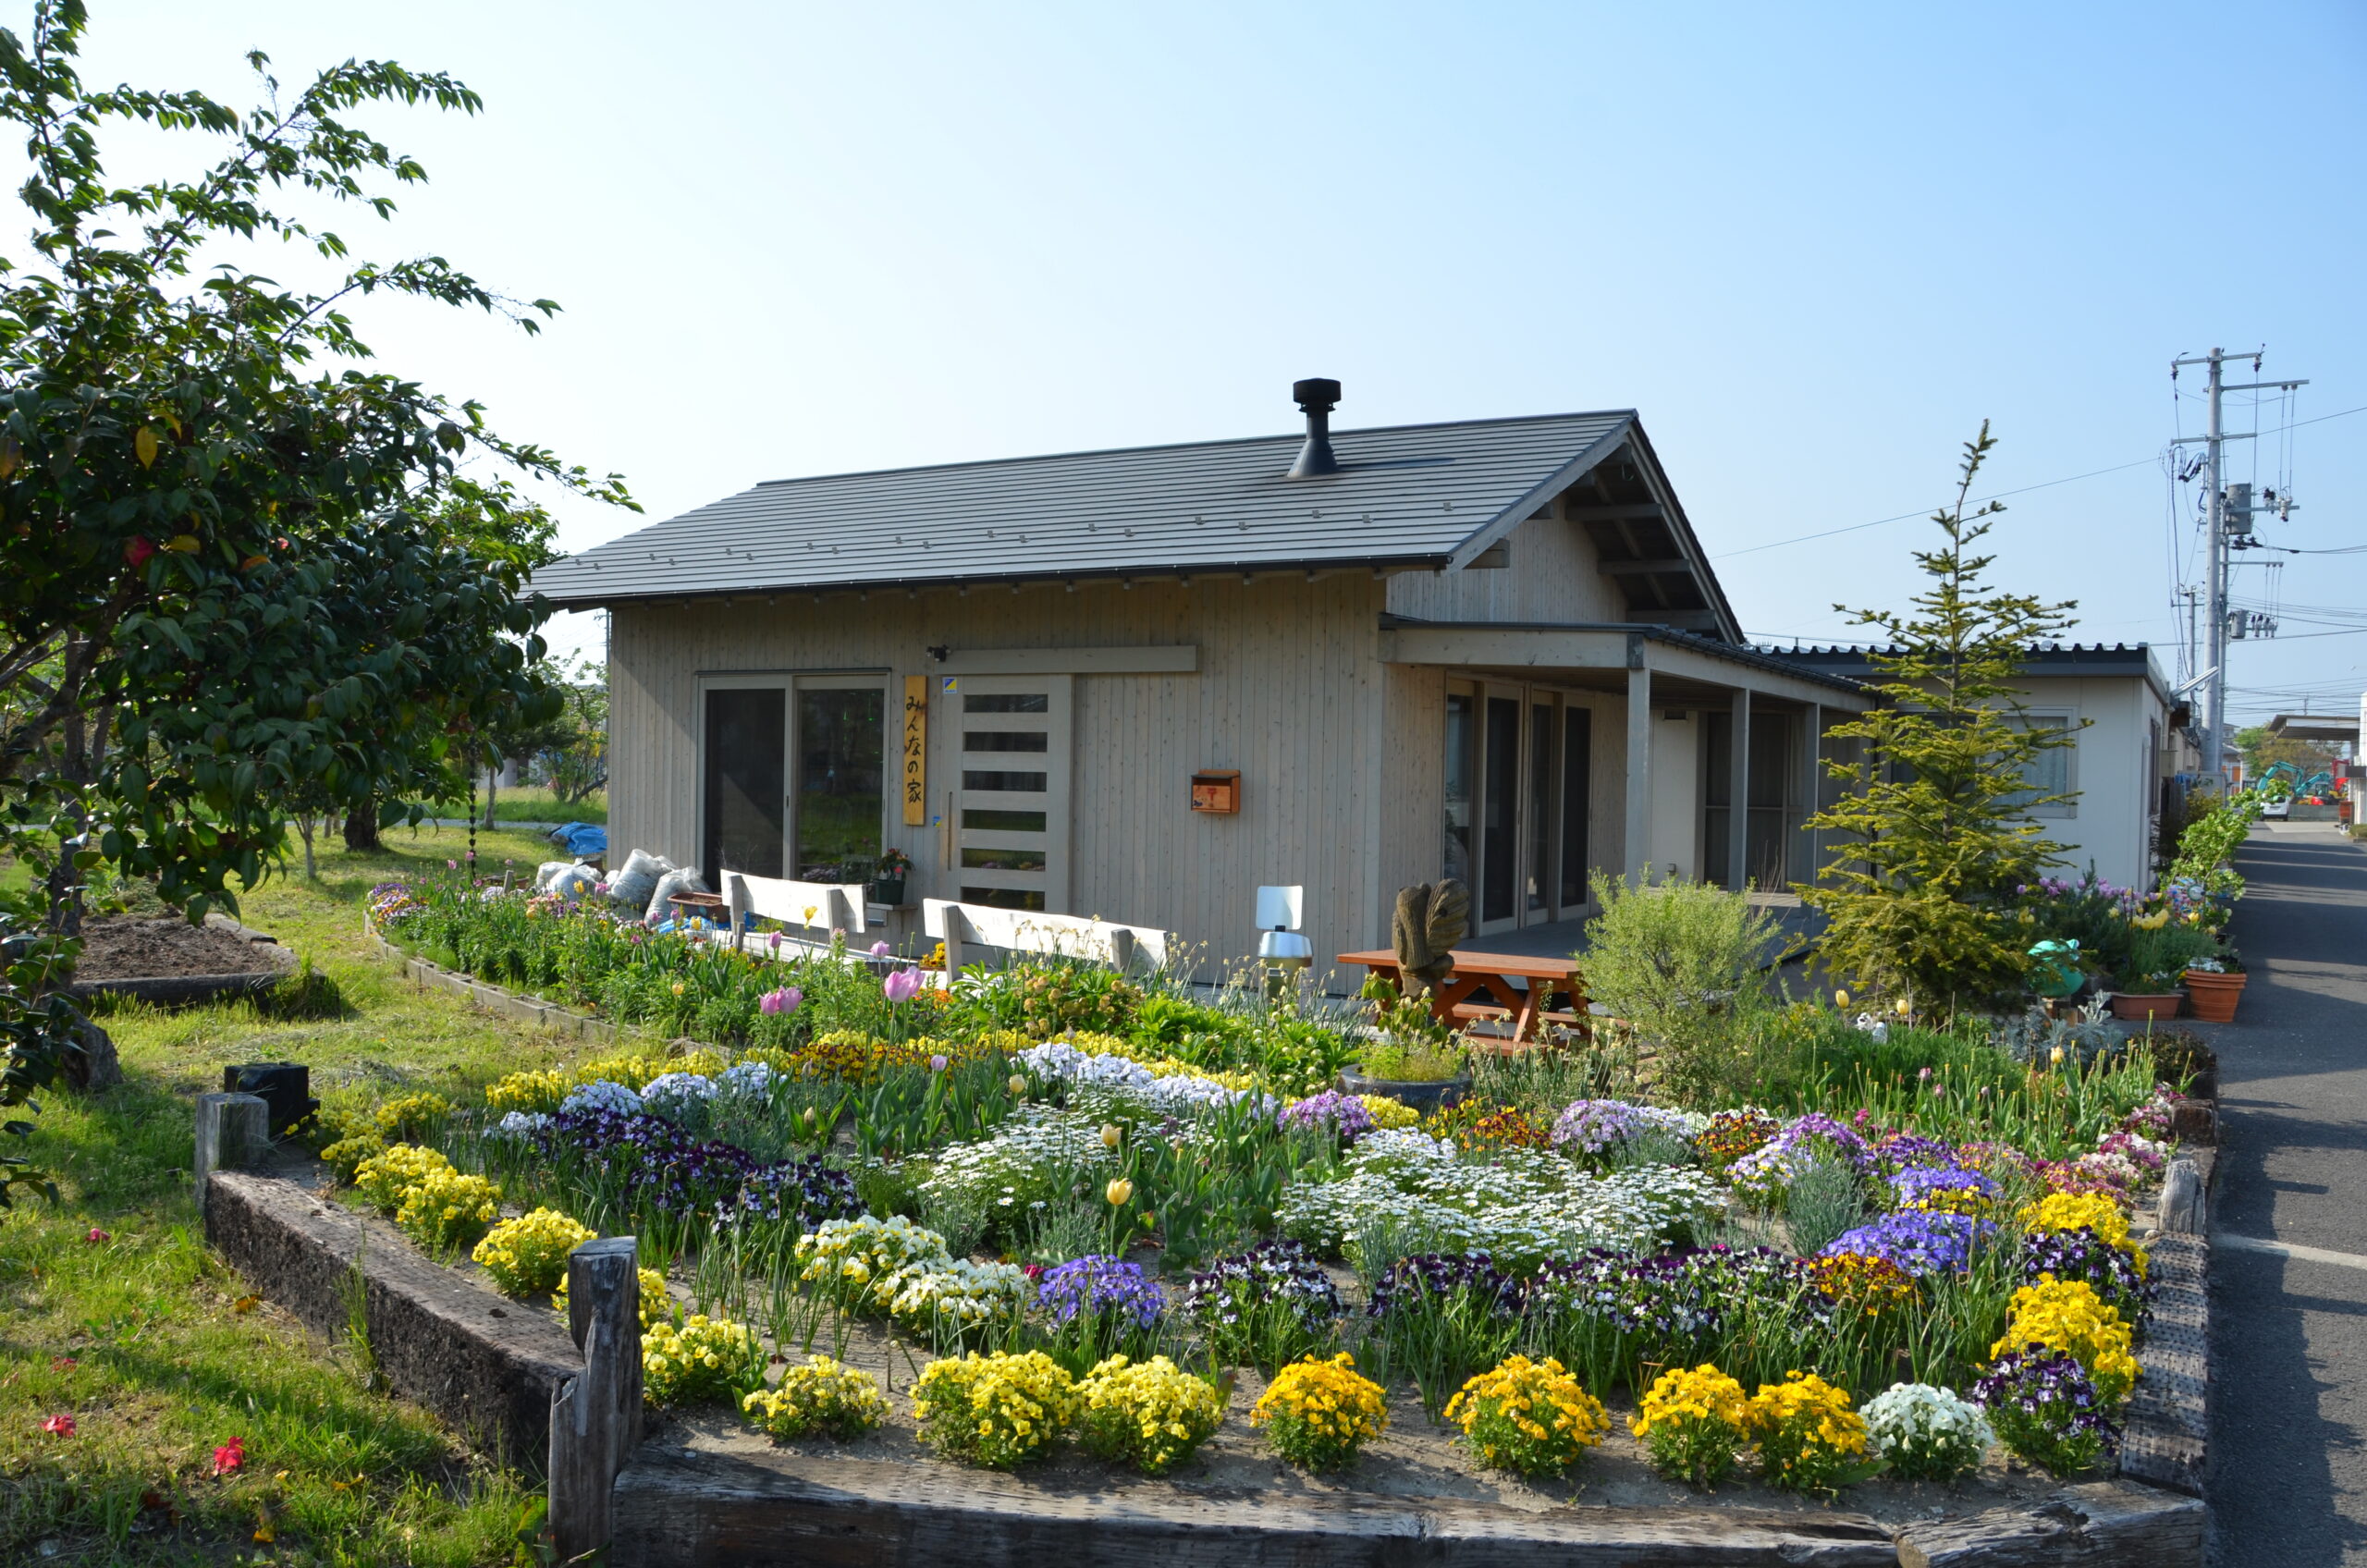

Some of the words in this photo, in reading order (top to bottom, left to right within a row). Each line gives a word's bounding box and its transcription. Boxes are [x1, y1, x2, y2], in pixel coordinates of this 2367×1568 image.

[906, 695, 923, 803] みんなの家
